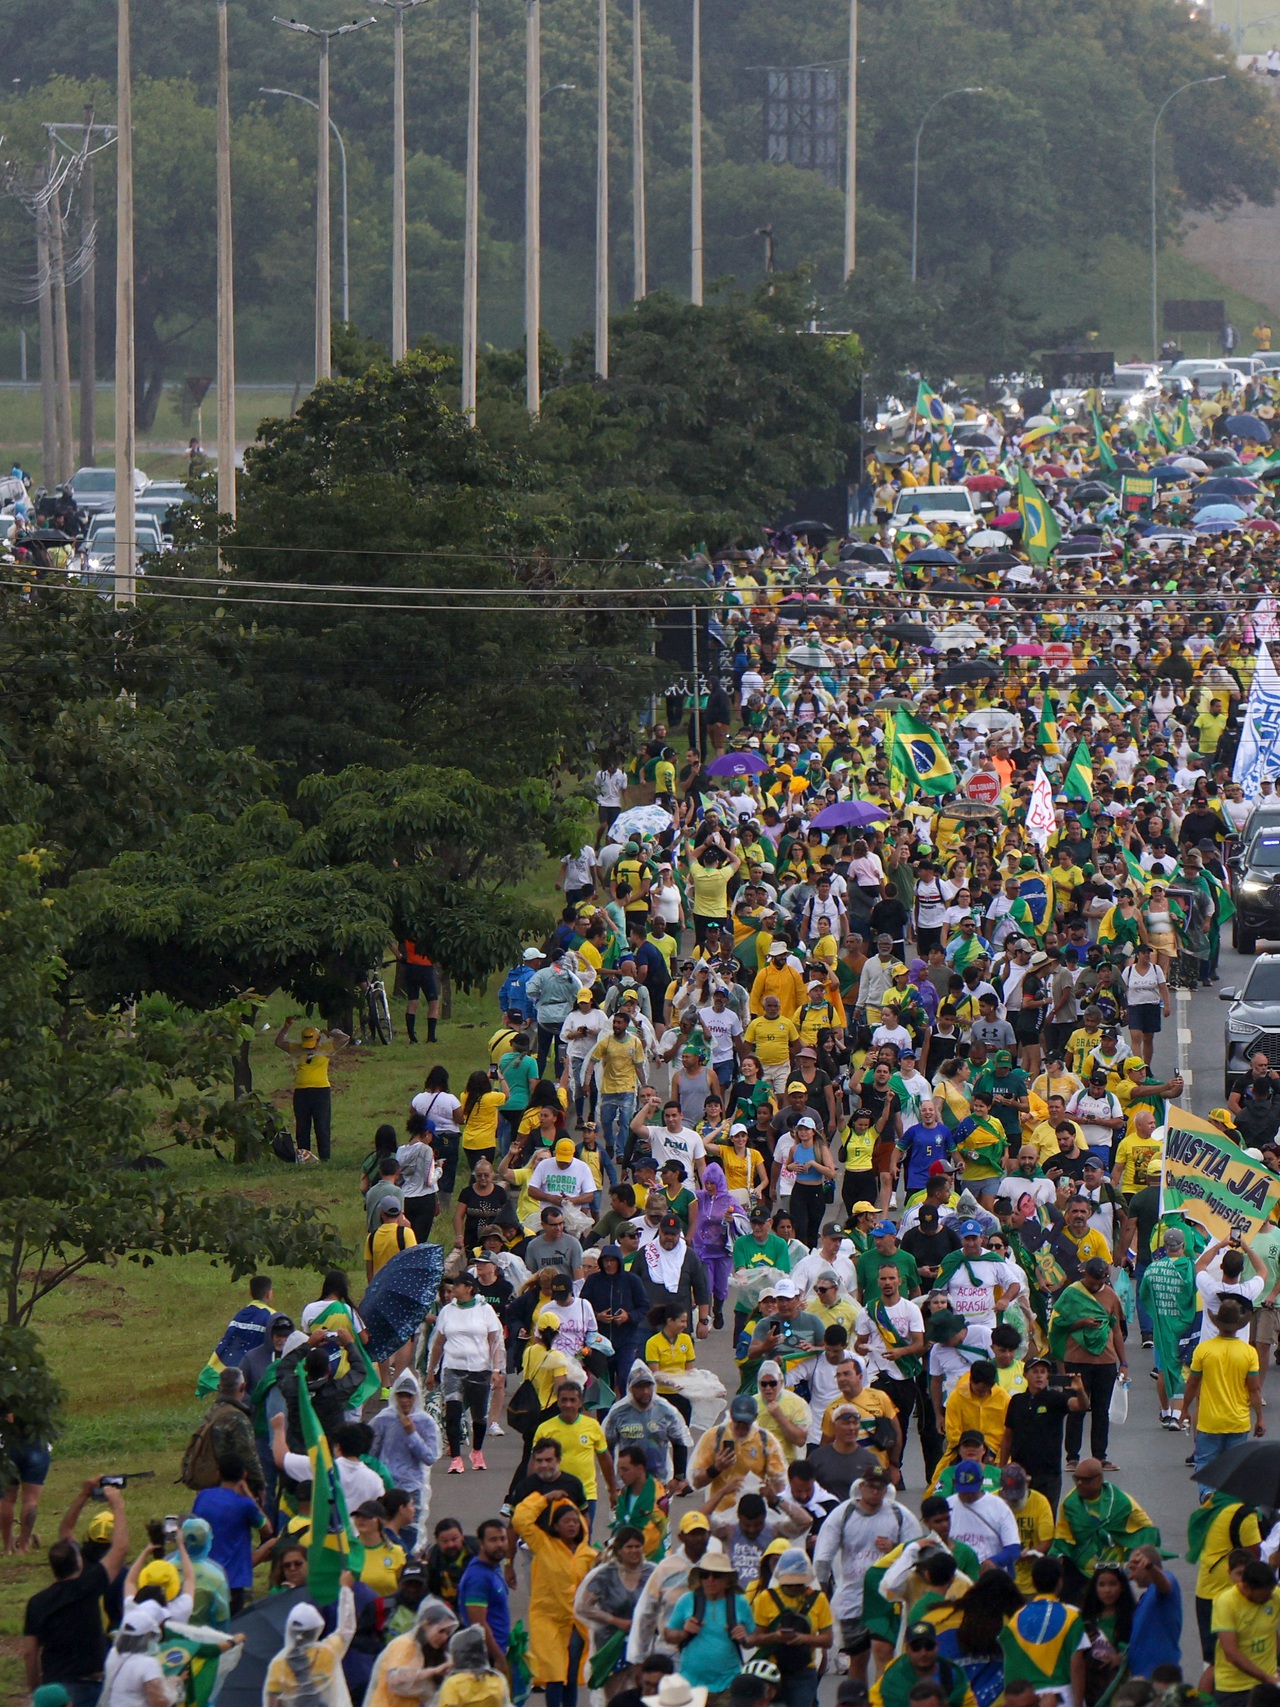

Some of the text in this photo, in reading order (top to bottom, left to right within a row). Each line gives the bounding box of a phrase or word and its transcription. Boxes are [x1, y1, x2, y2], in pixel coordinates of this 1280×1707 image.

[969, 782, 996, 792] BOLSONARO
[926, 1146, 932, 1156] 5
[546, 1175, 577, 1185] ACORDA
[547, 1183, 577, 1193] BRASIL!
[1178, 1176, 1204, 1200] dessa
[1227, 1171, 1274, 1212] JÁ
[1251, 1639, 1265, 1653] 10
